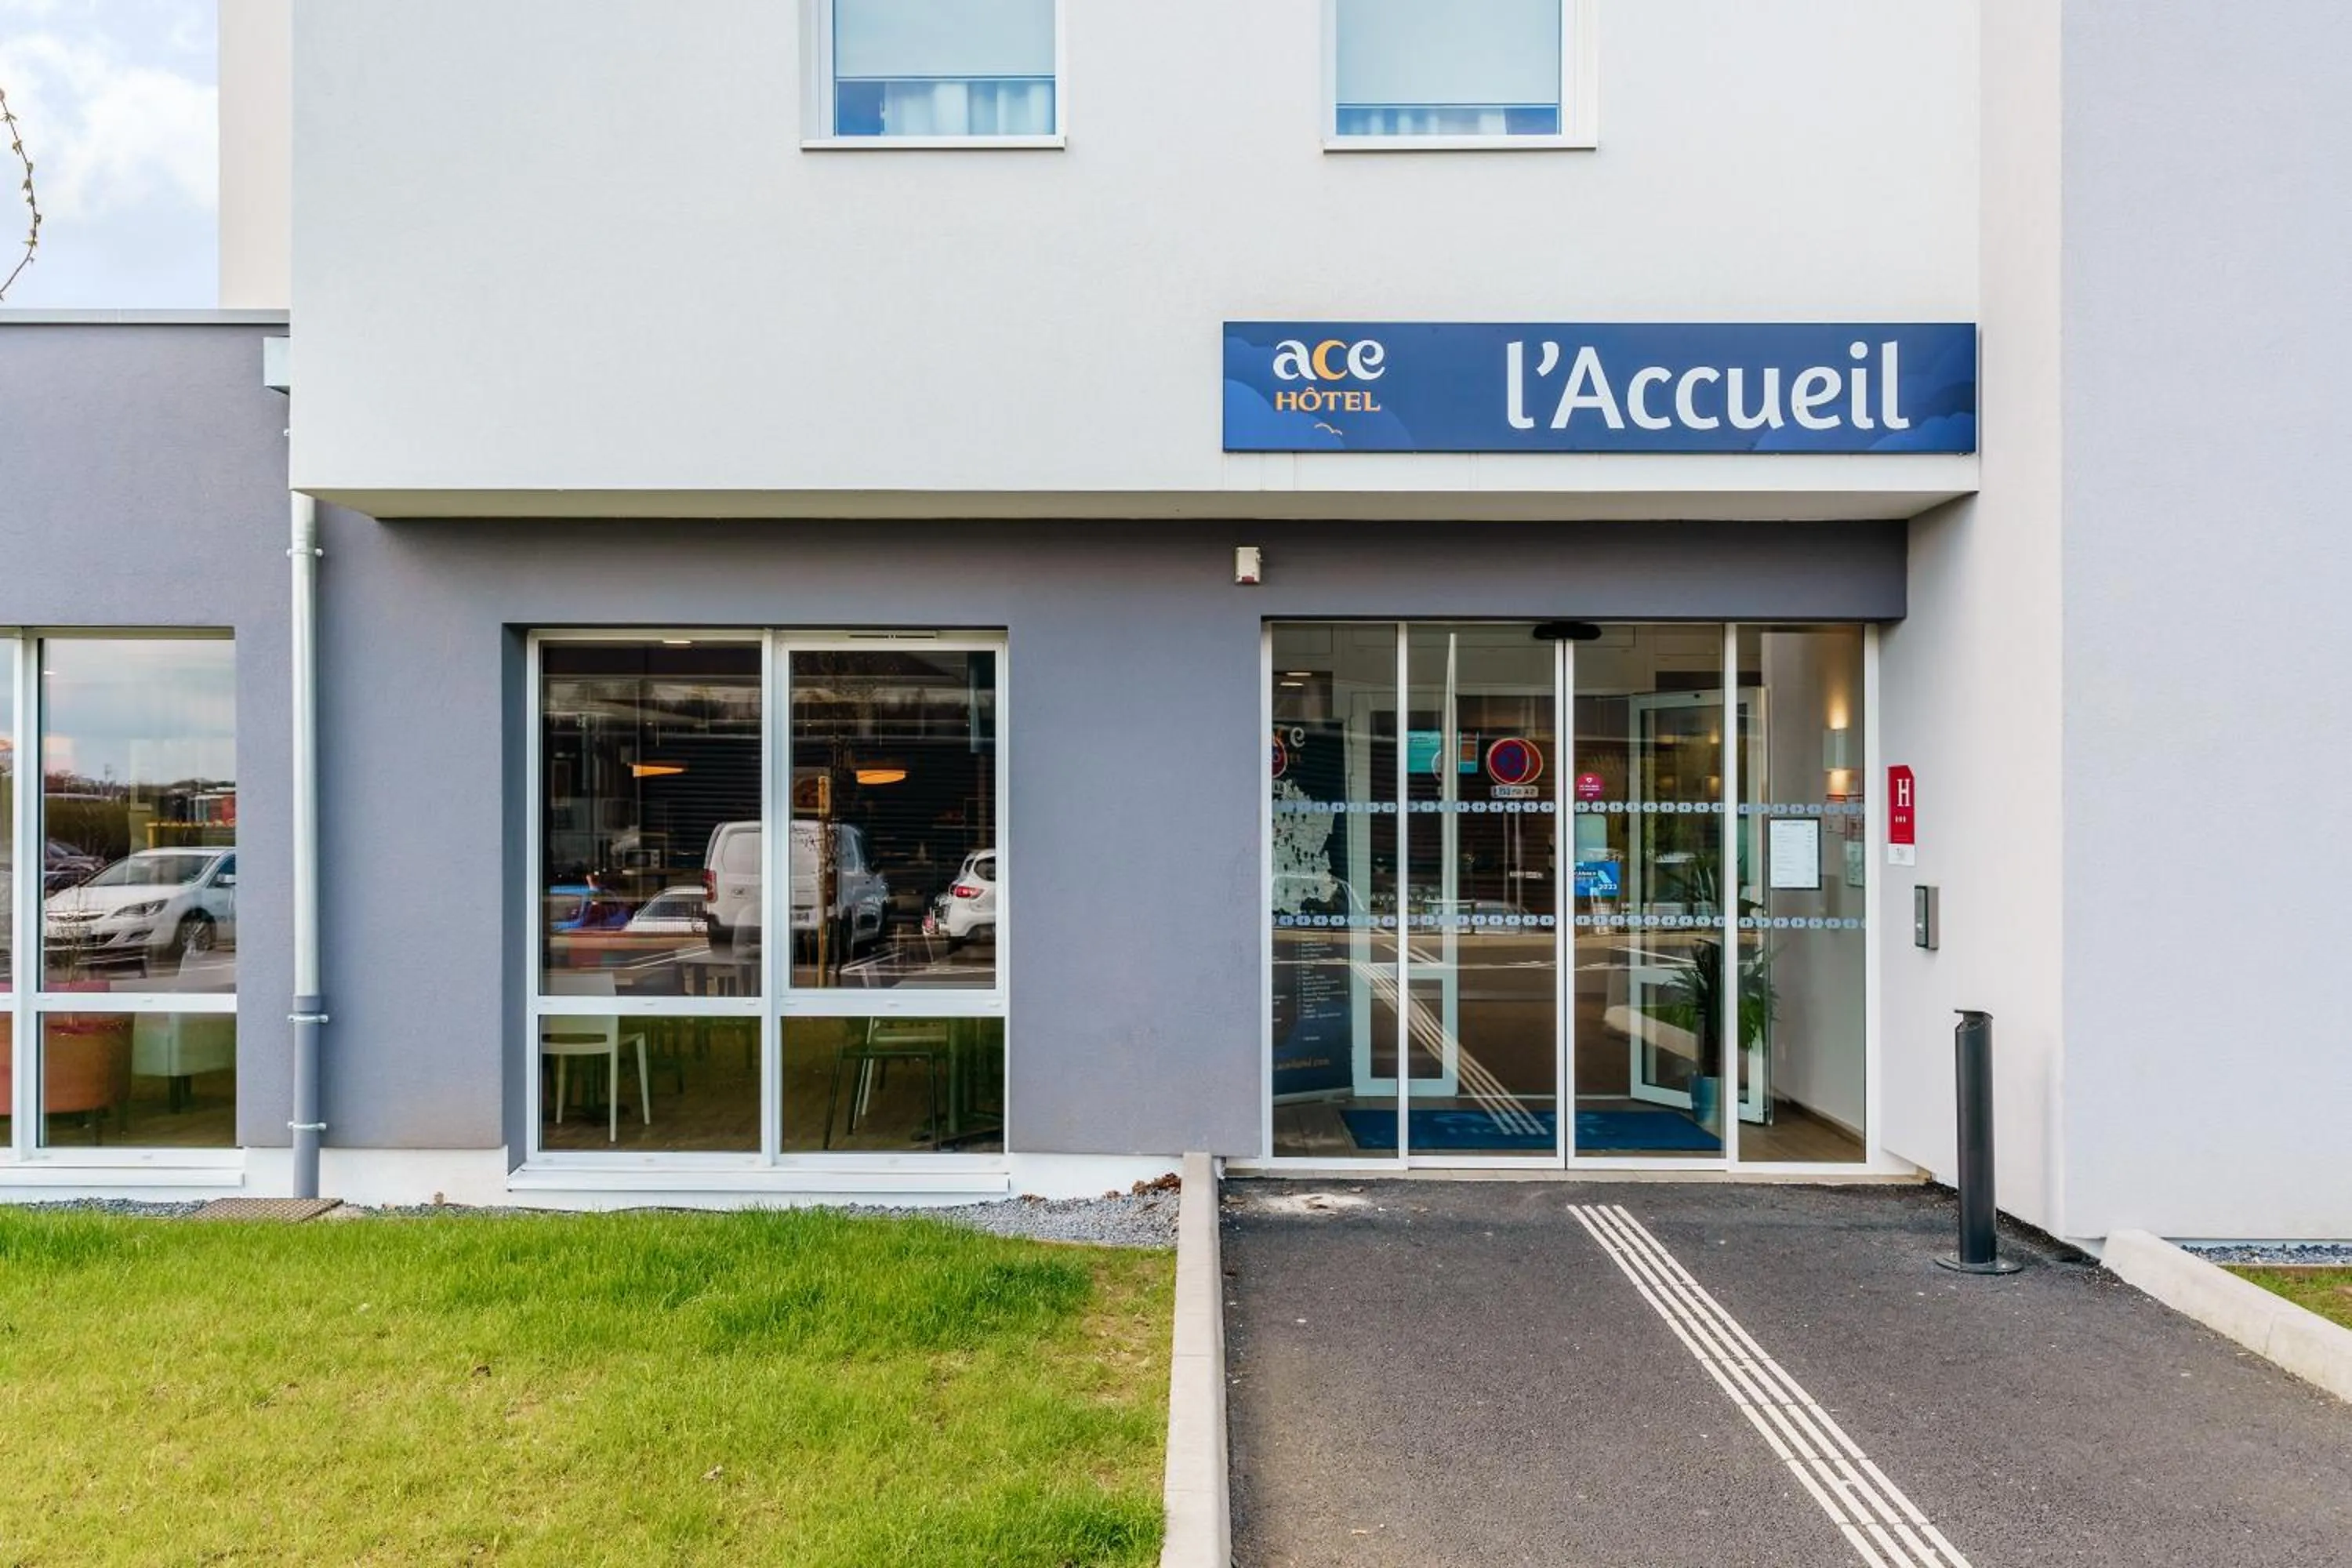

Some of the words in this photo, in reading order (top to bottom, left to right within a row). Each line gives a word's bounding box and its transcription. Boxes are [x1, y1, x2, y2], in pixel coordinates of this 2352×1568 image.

[1272, 339, 1385, 380] ace
[1276, 387, 1381, 412] HÔTEL
[1507, 339, 1910, 430] l'Accueil
[1897, 778, 1911, 807] H
